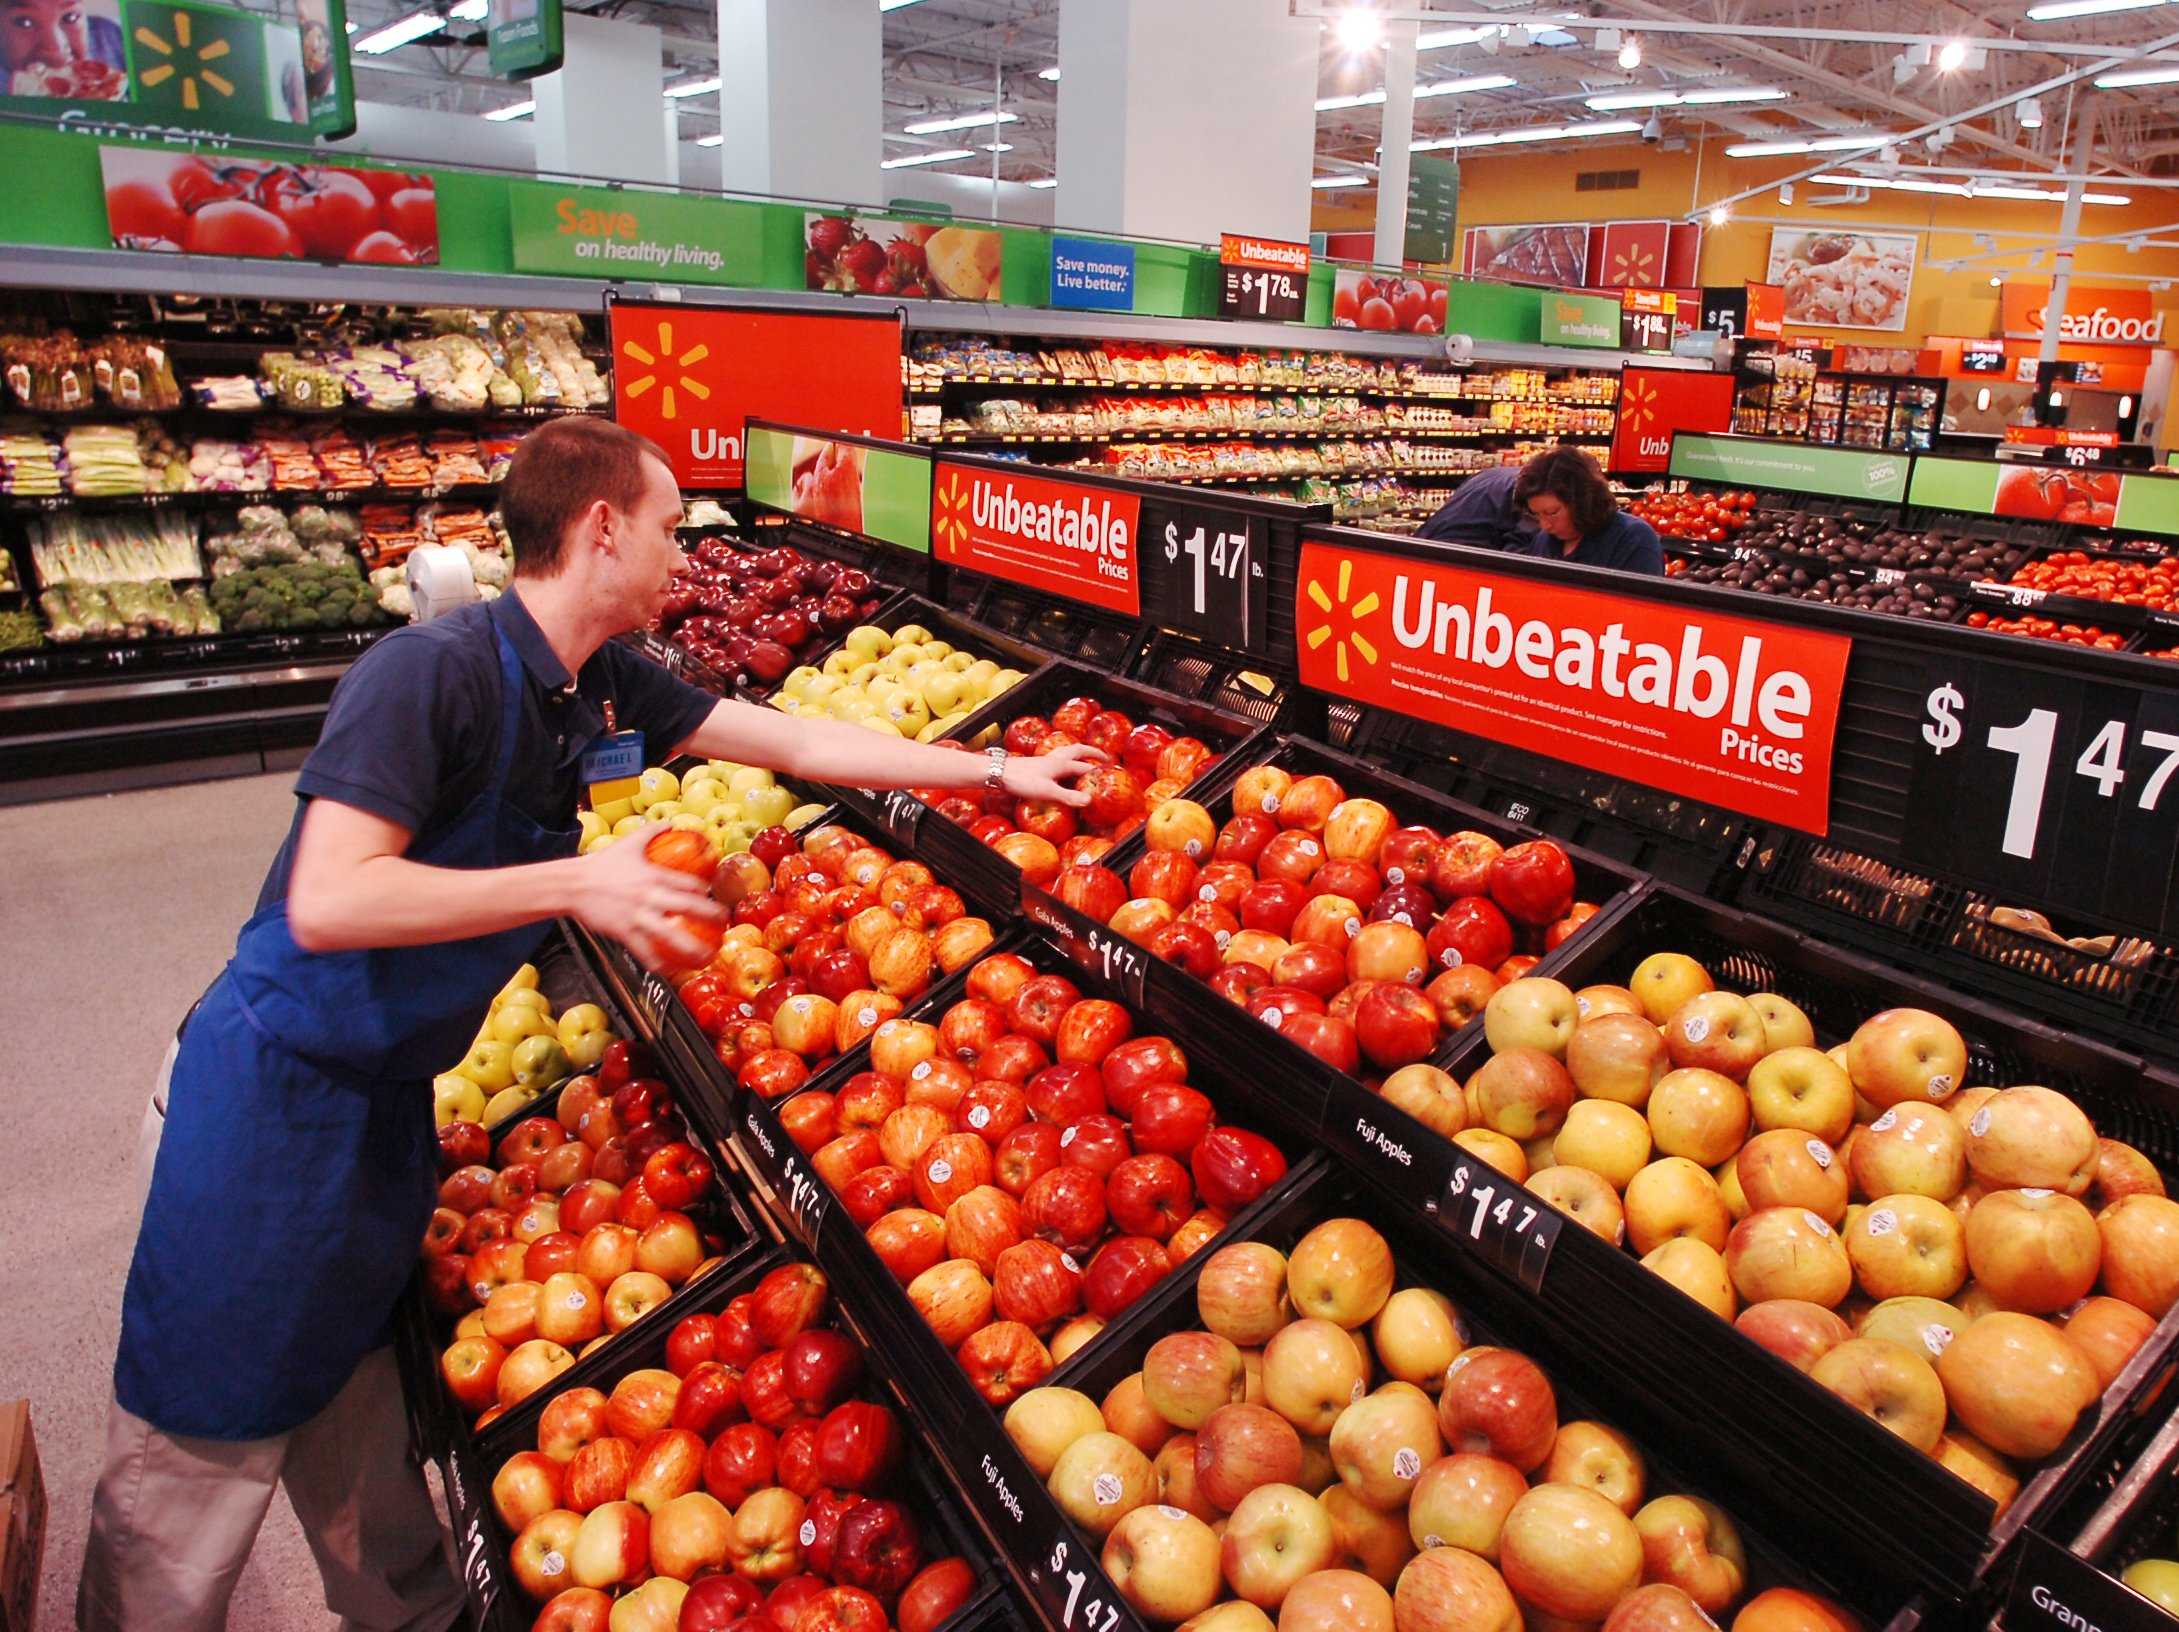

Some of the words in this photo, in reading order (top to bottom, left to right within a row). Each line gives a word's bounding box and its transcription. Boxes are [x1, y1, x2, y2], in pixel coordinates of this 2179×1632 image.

[556, 198, 638, 240] Save
[575, 241, 600, 258] on
[604, 238, 672, 267] healthy
[673, 244, 725, 271] living.
[1056, 256, 1085, 272] Save
[1087, 262, 1129, 279] money.
[1240, 242, 1306, 265] Unbeatable
[1057, 273, 1083, 289] Live
[1085, 275, 1126, 292] better.
[691, 428, 744, 460] Un
[1640, 437, 1669, 455] Unb
[972, 480, 1128, 559] Unbeatable
[1098, 557, 1128, 581] Prices
[1252, 561, 1264, 578] lb.
[1391, 575, 1813, 740] Unbeatable
[1720, 727, 1803, 775] Prices
[1356, 1118, 1376, 1142] Fuji
[1375, 1133, 1412, 1166] Apples
[981, 1454, 999, 1483] Fuji
[995, 1477, 1024, 1522] Apples
